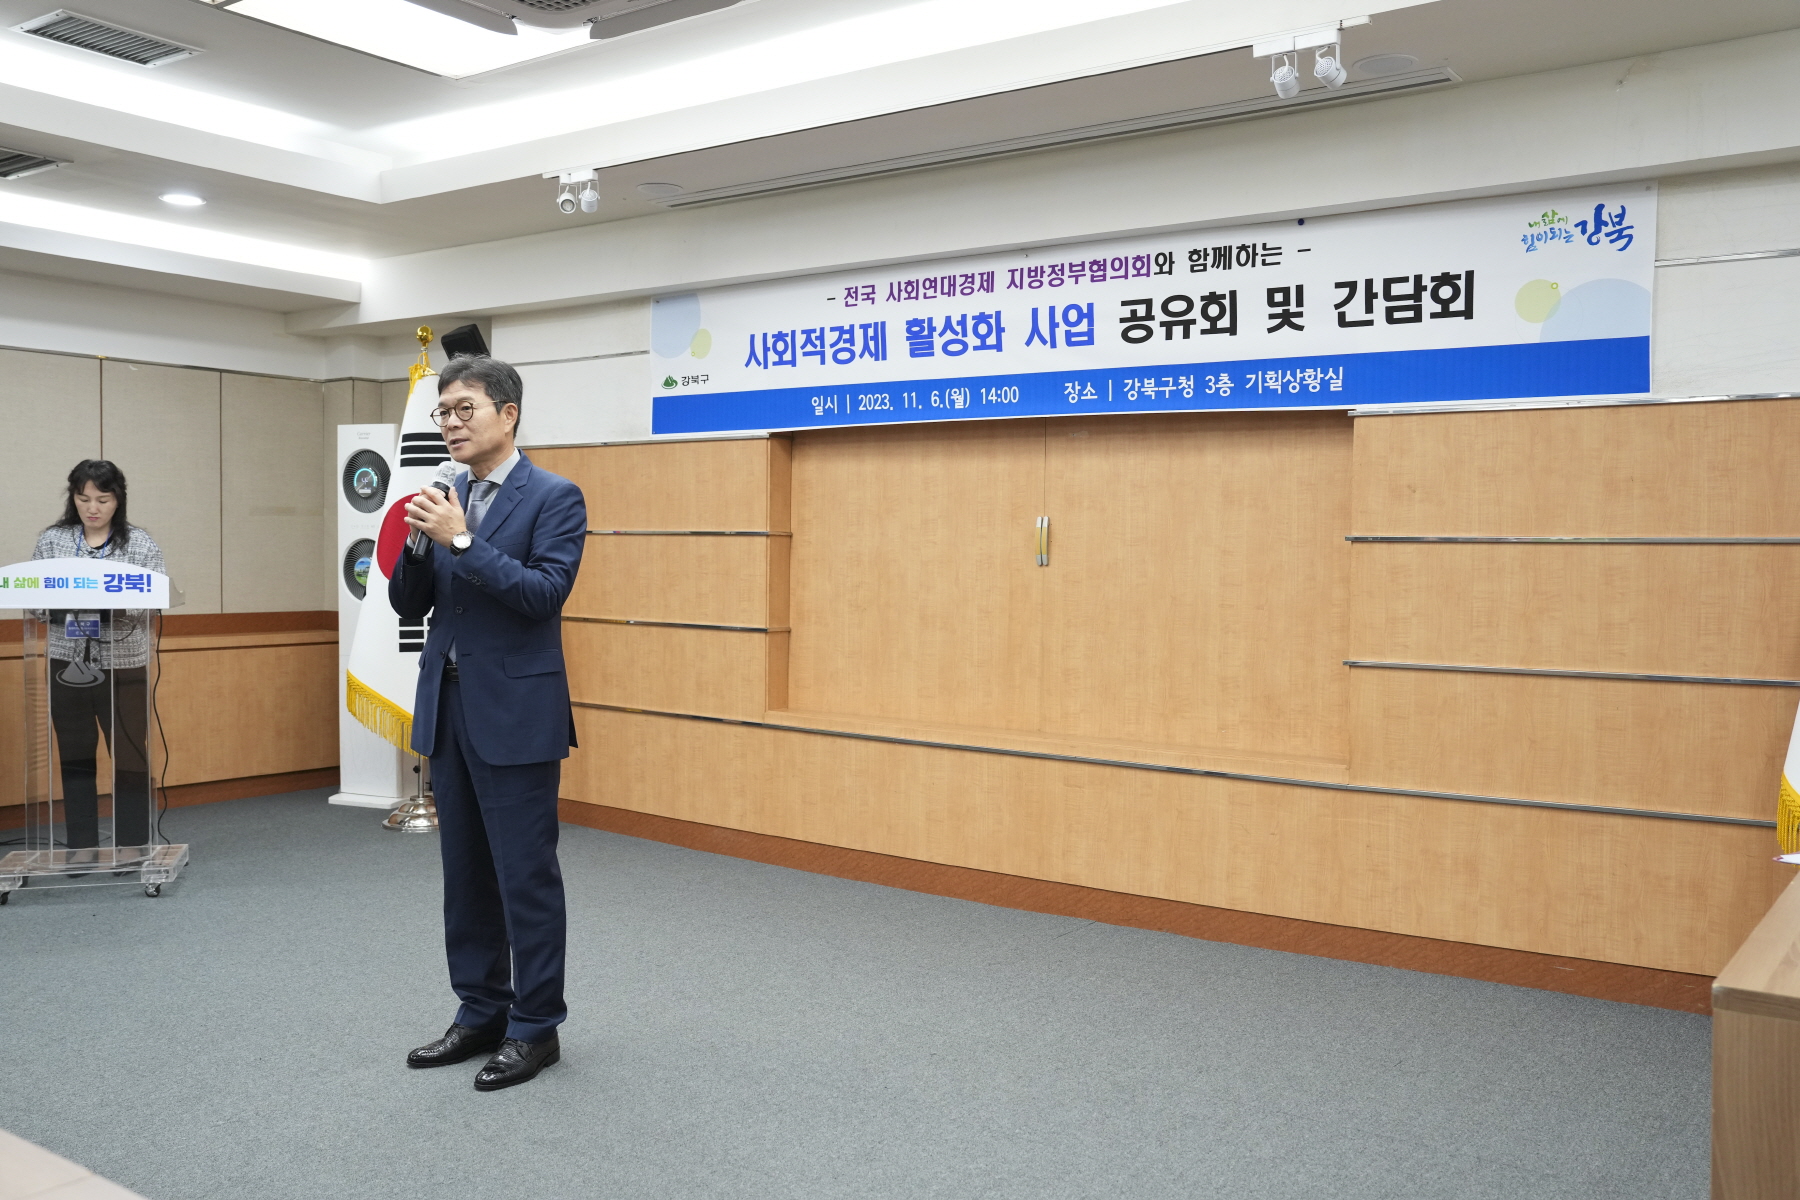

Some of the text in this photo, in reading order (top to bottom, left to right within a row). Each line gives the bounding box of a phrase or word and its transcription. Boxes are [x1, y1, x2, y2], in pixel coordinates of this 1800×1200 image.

[1574, 203, 1634, 252] 강북
[843, 284, 876, 308] 전국
[885, 270, 995, 303] 사회연대경제
[1006, 252, 1176, 290] 지방정부협의회와
[1187, 242, 1283, 274] 함께하는
[744, 269, 1475, 370] 사회적경제 활성화 사업 공유회 및 간담회
[681, 374, 709, 387] 강북구
[1063, 380, 1098, 404] 장소
[1123, 374, 1194, 401] 강북구청
[1205, 372, 1235, 397] 3층
[1245, 366, 1343, 394] 기획상황실
[811, 394, 838, 416] 일시
[858, 393, 894, 411] 2023.
[902, 391, 922, 410] 11.
[980, 385, 1019, 405] 14:00
[14, 577, 39, 589] 삶에
[44, 577, 69, 589] 힘이
[73, 577, 98, 589] 되는
[103, 573, 152, 593] 강북!
